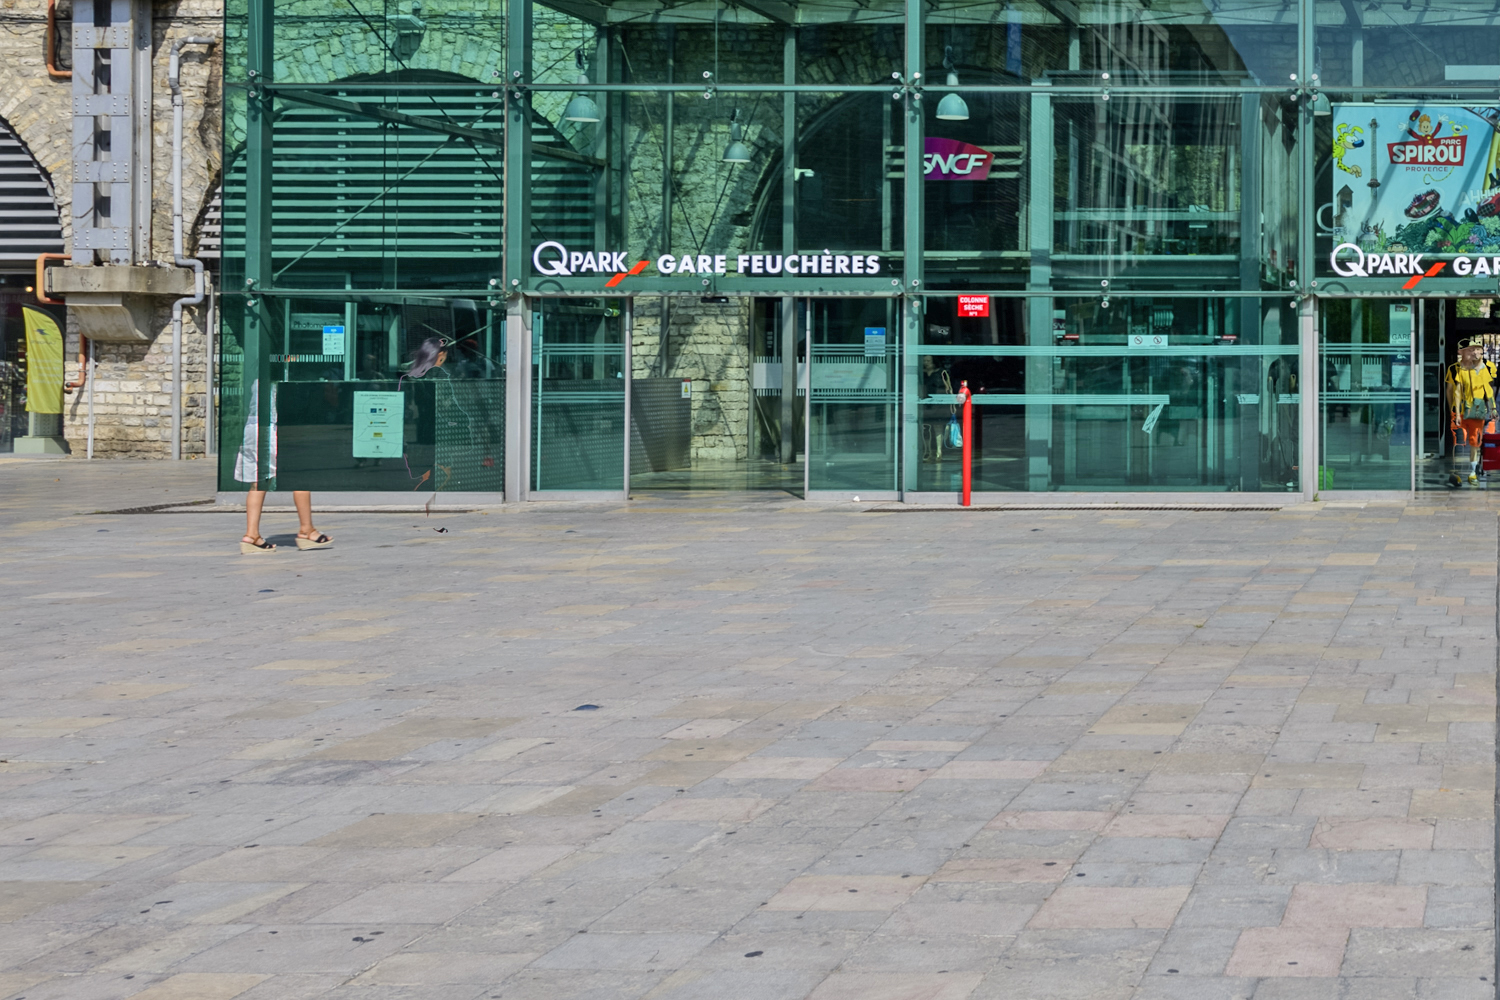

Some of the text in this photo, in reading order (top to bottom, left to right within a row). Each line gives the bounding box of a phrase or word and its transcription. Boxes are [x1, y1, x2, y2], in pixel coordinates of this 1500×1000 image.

[1440, 138, 1462, 146] PARC
[1392, 144, 1462, 163] SPIROU
[657, 254, 727, 274] GARE
[737, 248, 881, 274] FEUCHÈRES
[963, 302, 984, 310] SÈCHE
